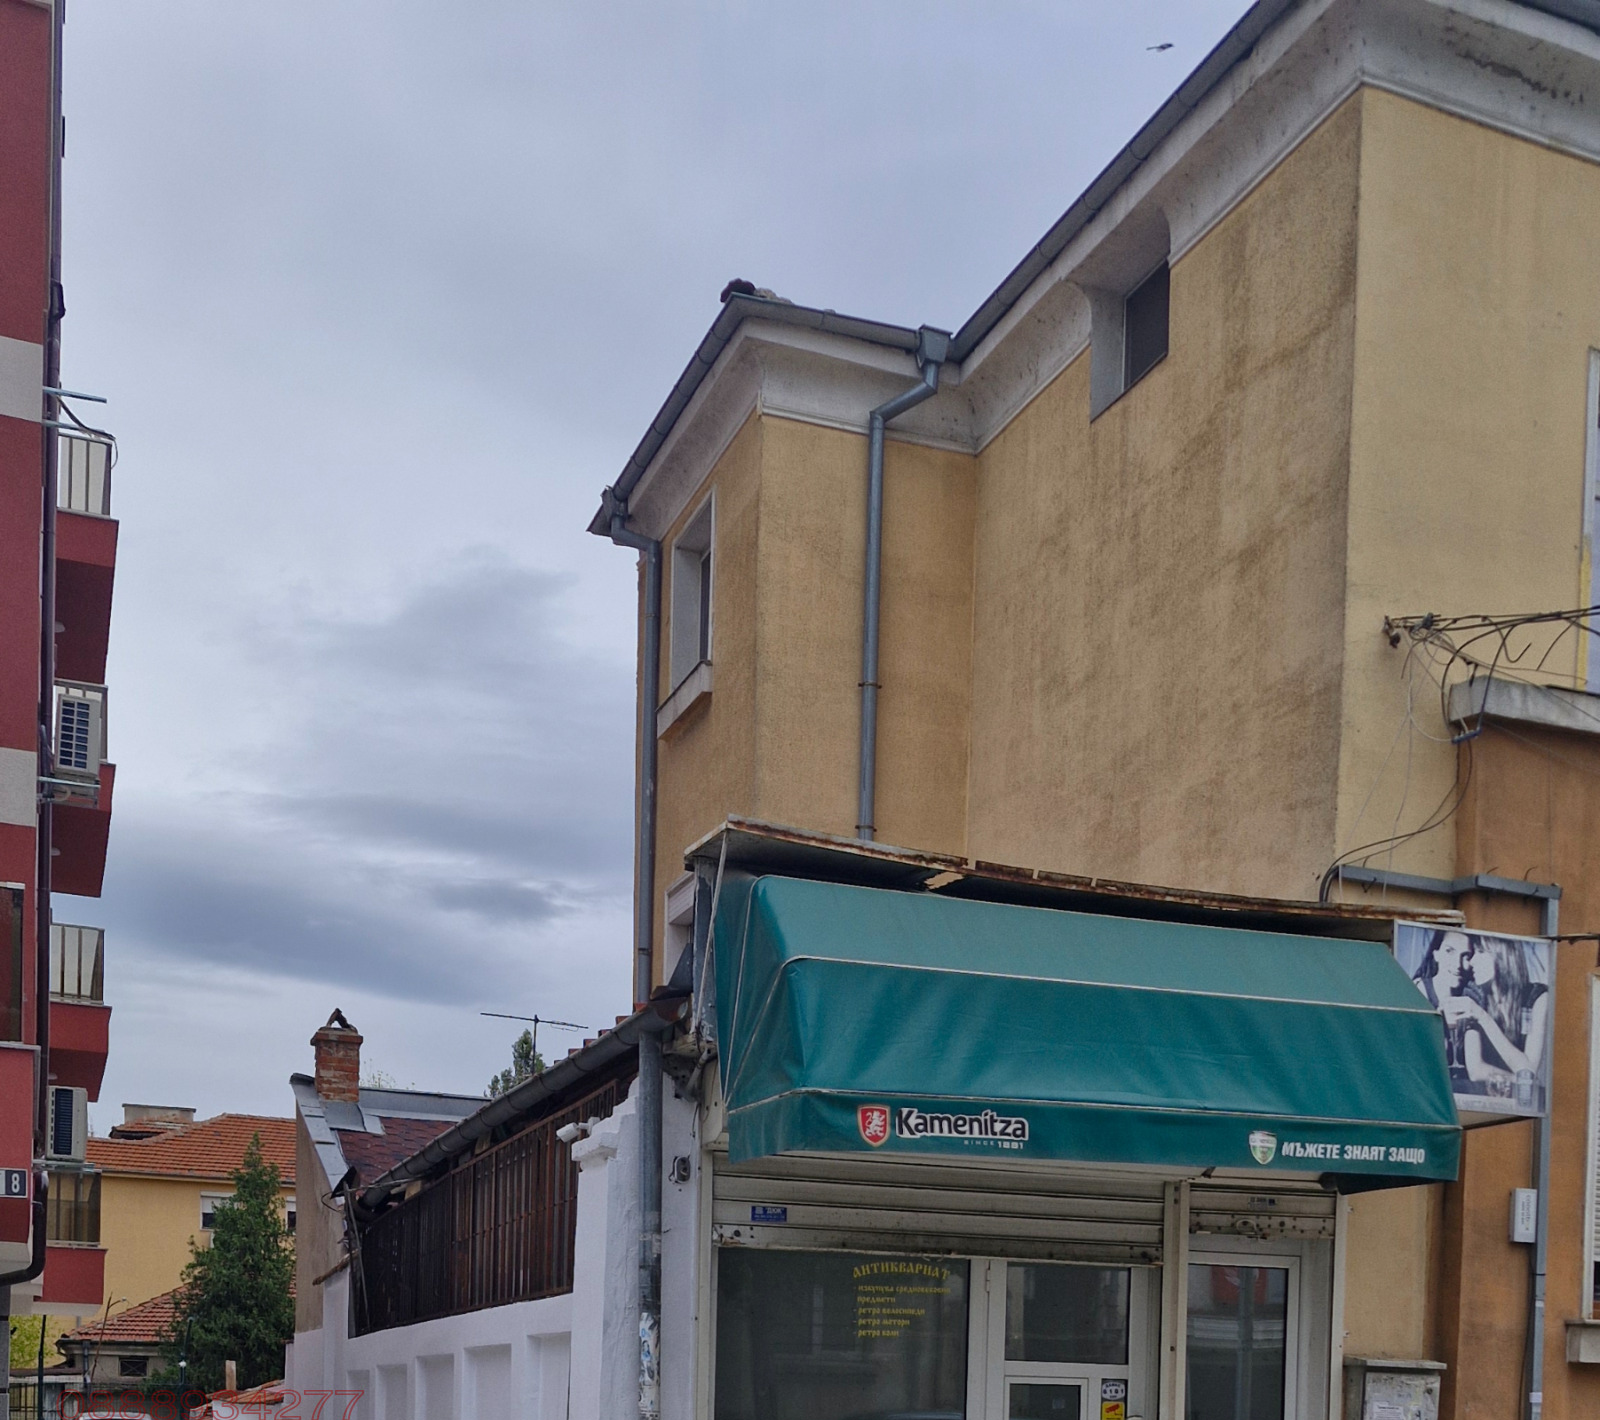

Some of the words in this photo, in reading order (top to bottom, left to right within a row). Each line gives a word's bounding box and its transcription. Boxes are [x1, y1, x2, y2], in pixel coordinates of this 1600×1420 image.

[998, 1141, 1024, 1149] 1881
[1282, 1142, 1340, 1159] МЪЖЕТЕ
[1344, 1145, 1386, 1161] ЗНАЯТ
[1388, 1147, 1426, 1164] ЗАЩО
[11, 1173, 20, 1193] 8
[853, 1262, 951, 1280] АНТИКВАРИАТ
